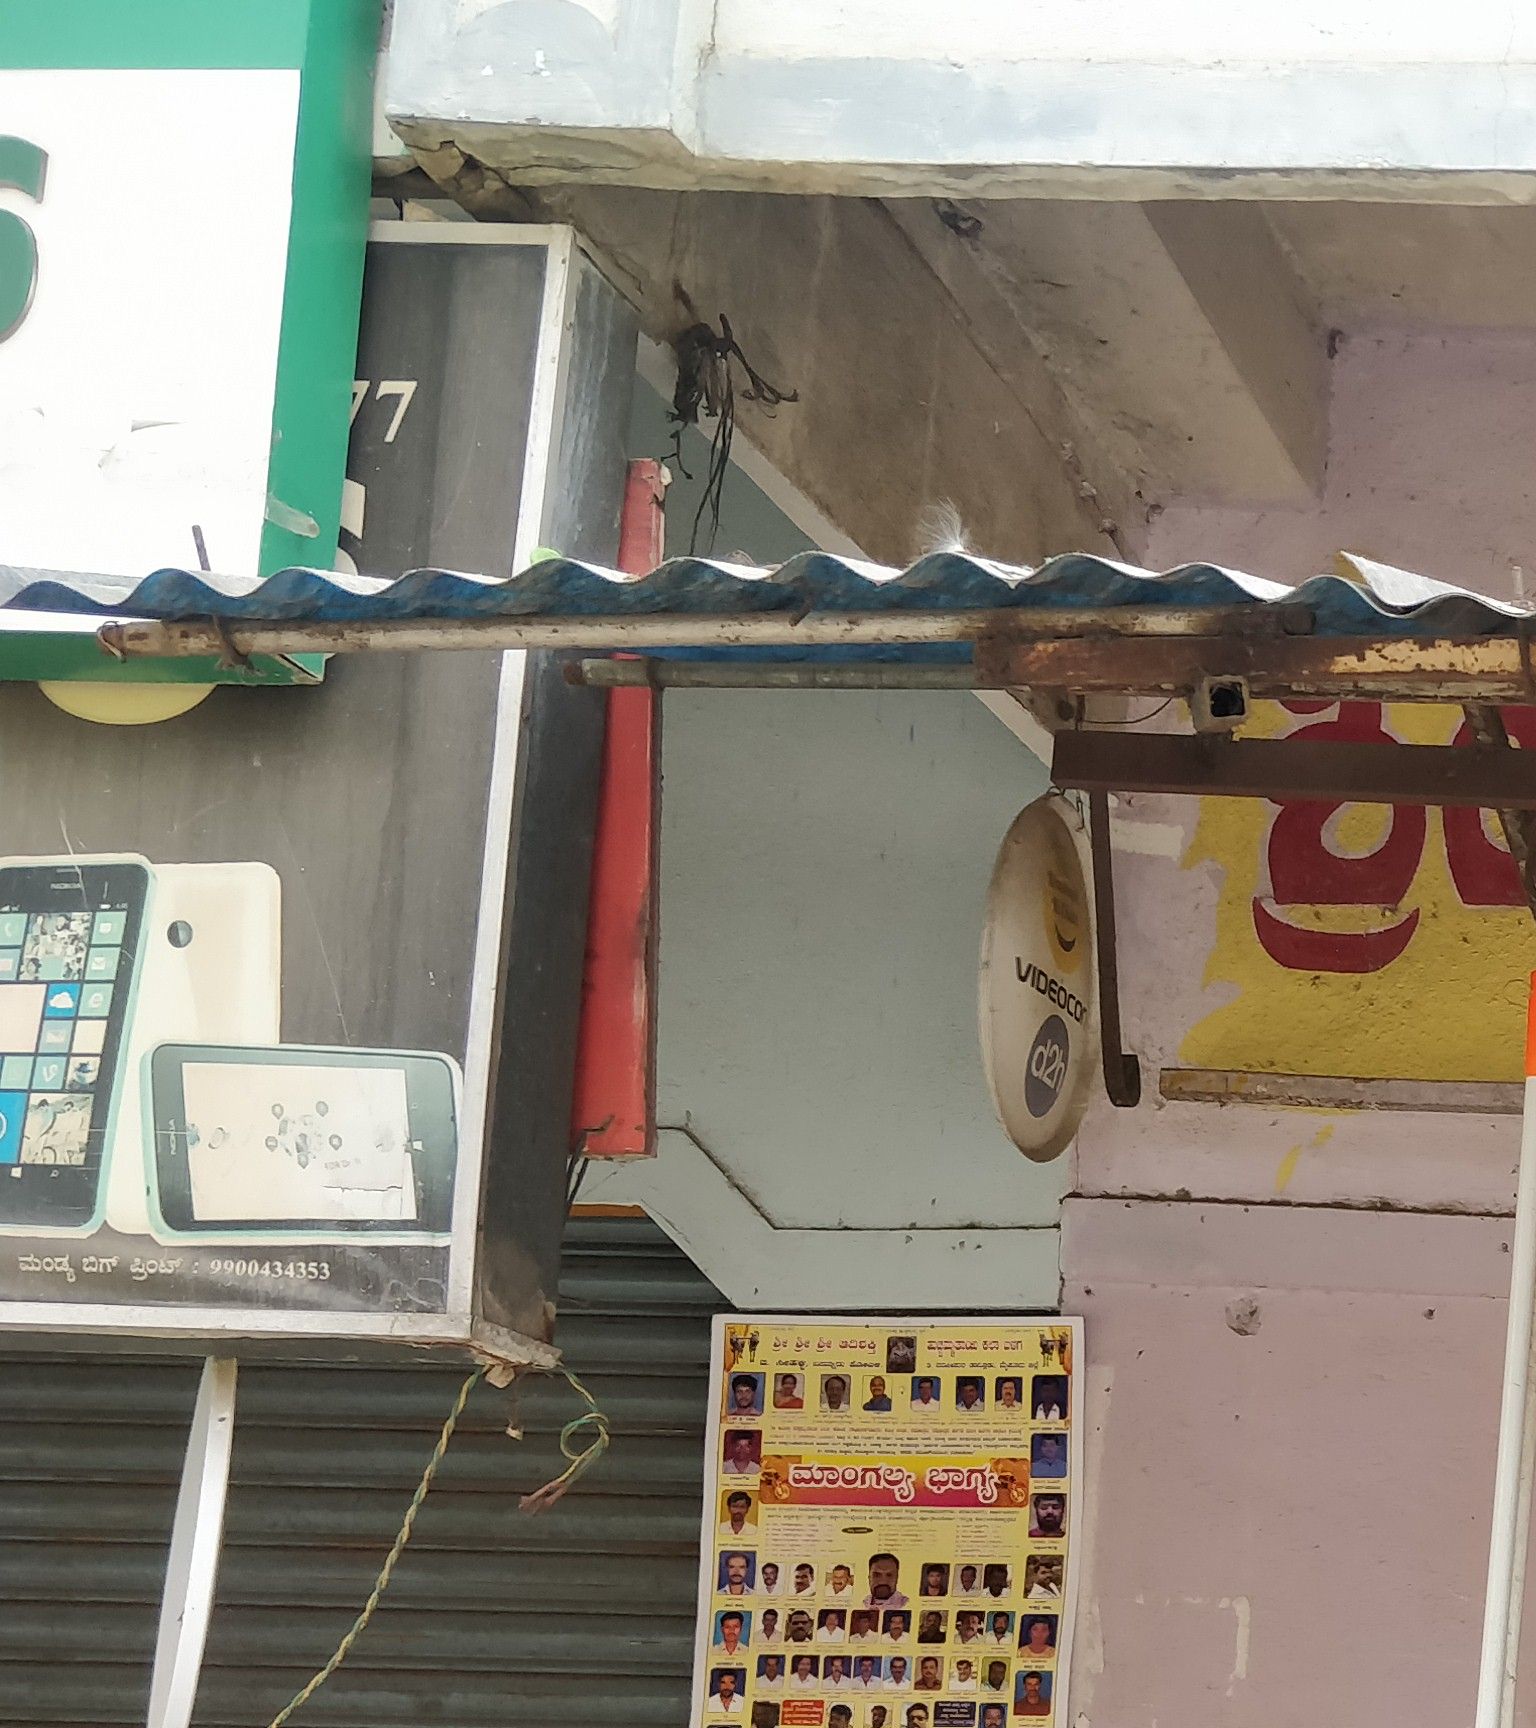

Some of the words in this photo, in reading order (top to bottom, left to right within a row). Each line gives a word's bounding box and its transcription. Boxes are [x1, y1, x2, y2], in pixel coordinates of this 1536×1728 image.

[209, 1257, 332, 1282] 9900434353
[790, 1463, 915, 1502] ಮಾಂಗಲ್ಯ
[926, 1464, 1000, 1503] ಭಾಗ್ಯ
